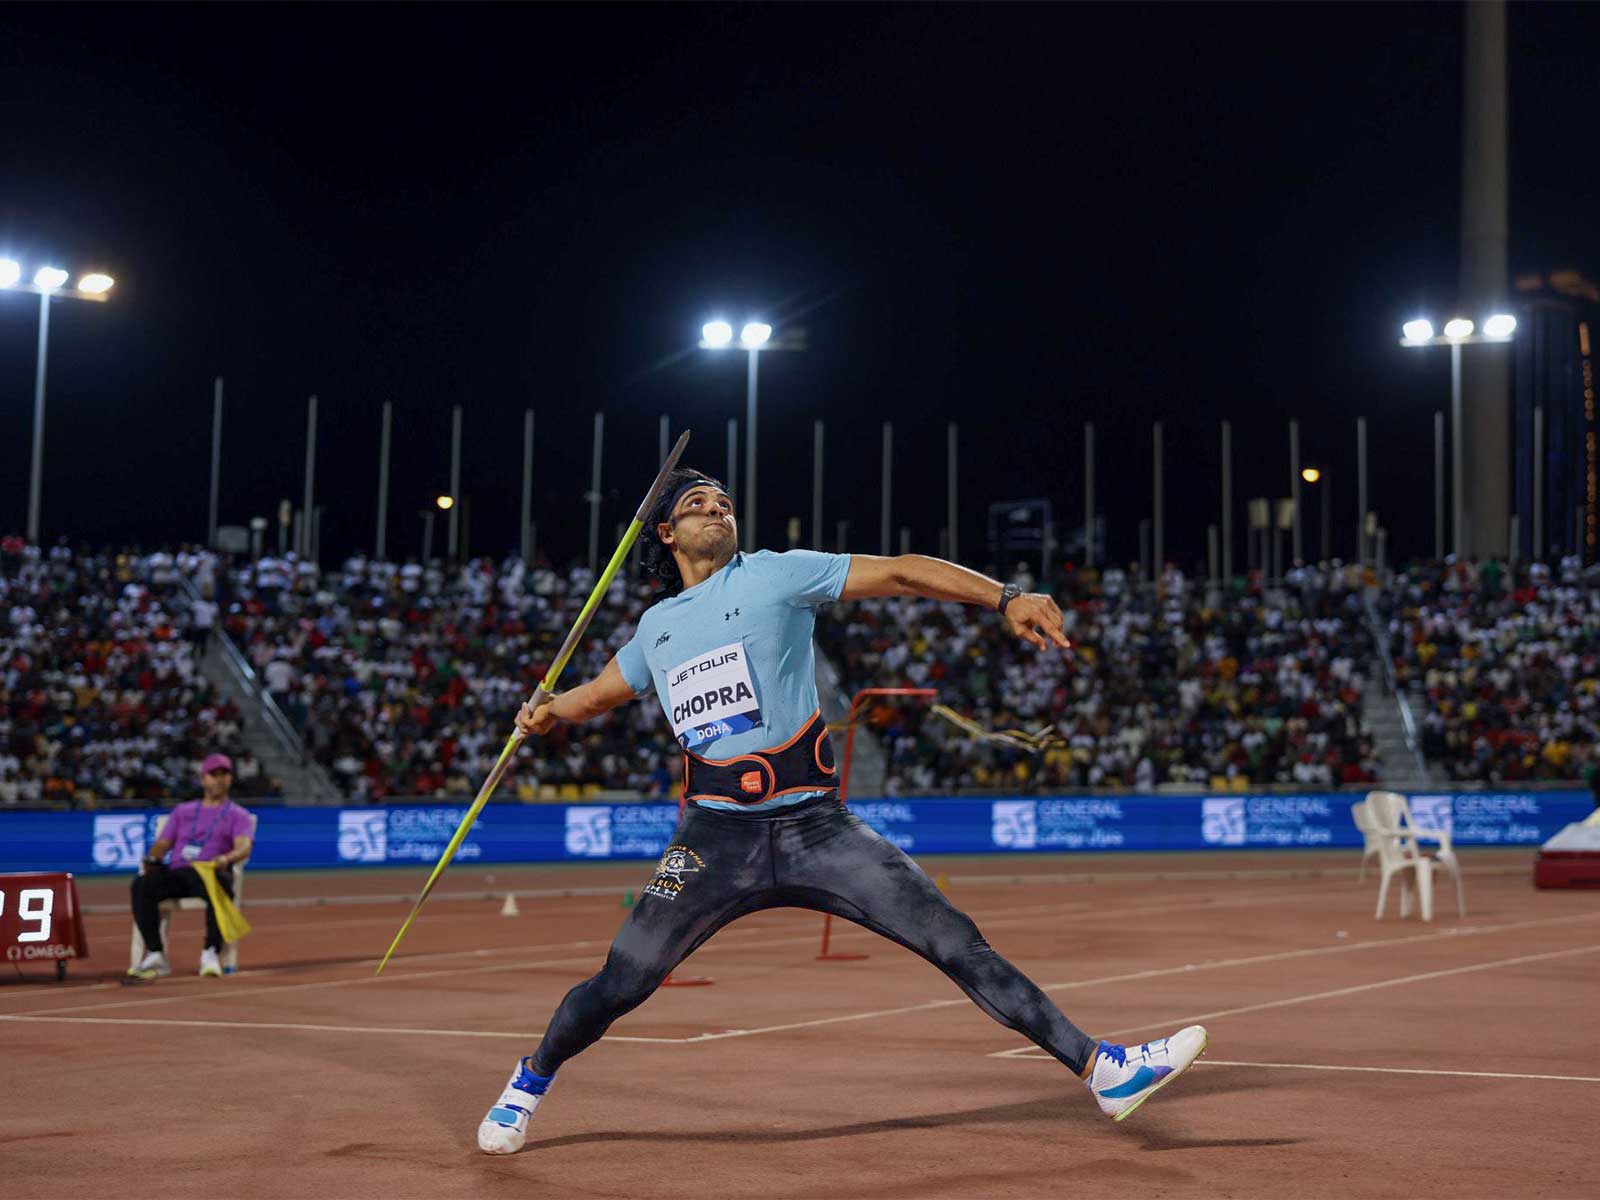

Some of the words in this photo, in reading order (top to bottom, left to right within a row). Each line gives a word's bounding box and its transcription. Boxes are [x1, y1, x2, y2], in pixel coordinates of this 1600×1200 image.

[671, 651, 738, 687] JETOUR
[673, 681, 753, 725] CHOPRA
[696, 723, 731, 740] DOHA
[0, 888, 54, 942] 9
[24, 943, 76, 960] OMEGA
